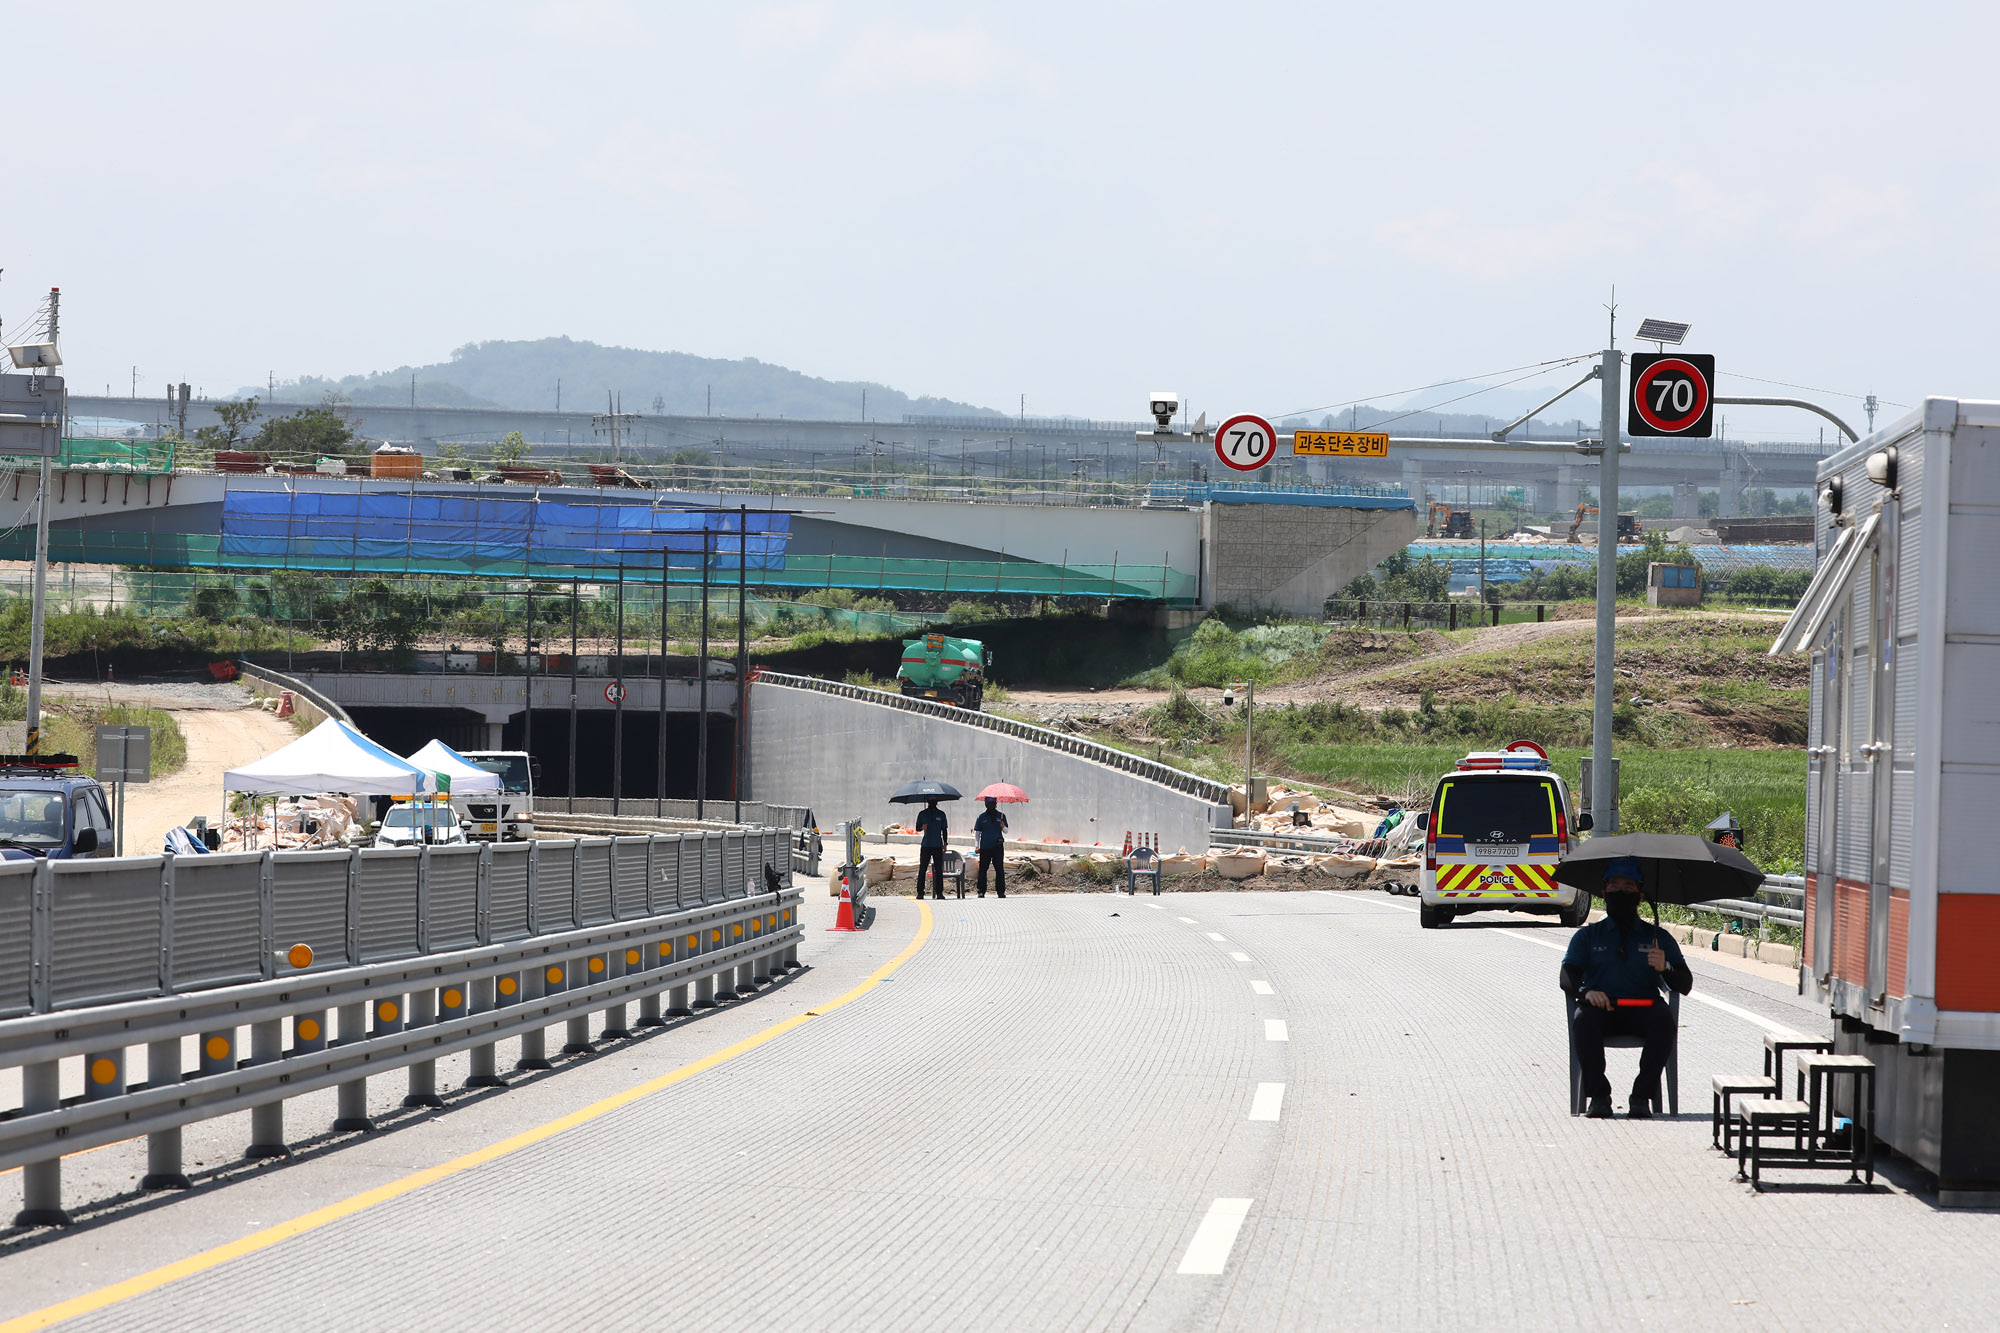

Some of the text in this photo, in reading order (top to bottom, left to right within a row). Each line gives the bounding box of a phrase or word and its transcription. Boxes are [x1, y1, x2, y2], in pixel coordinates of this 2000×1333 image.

[1652, 379, 1693, 413] 70
[1229, 430, 1264, 457] 70
[1298, 434, 1384, 454] 과속단속장비
[1479, 875, 1515, 884] POLICE
